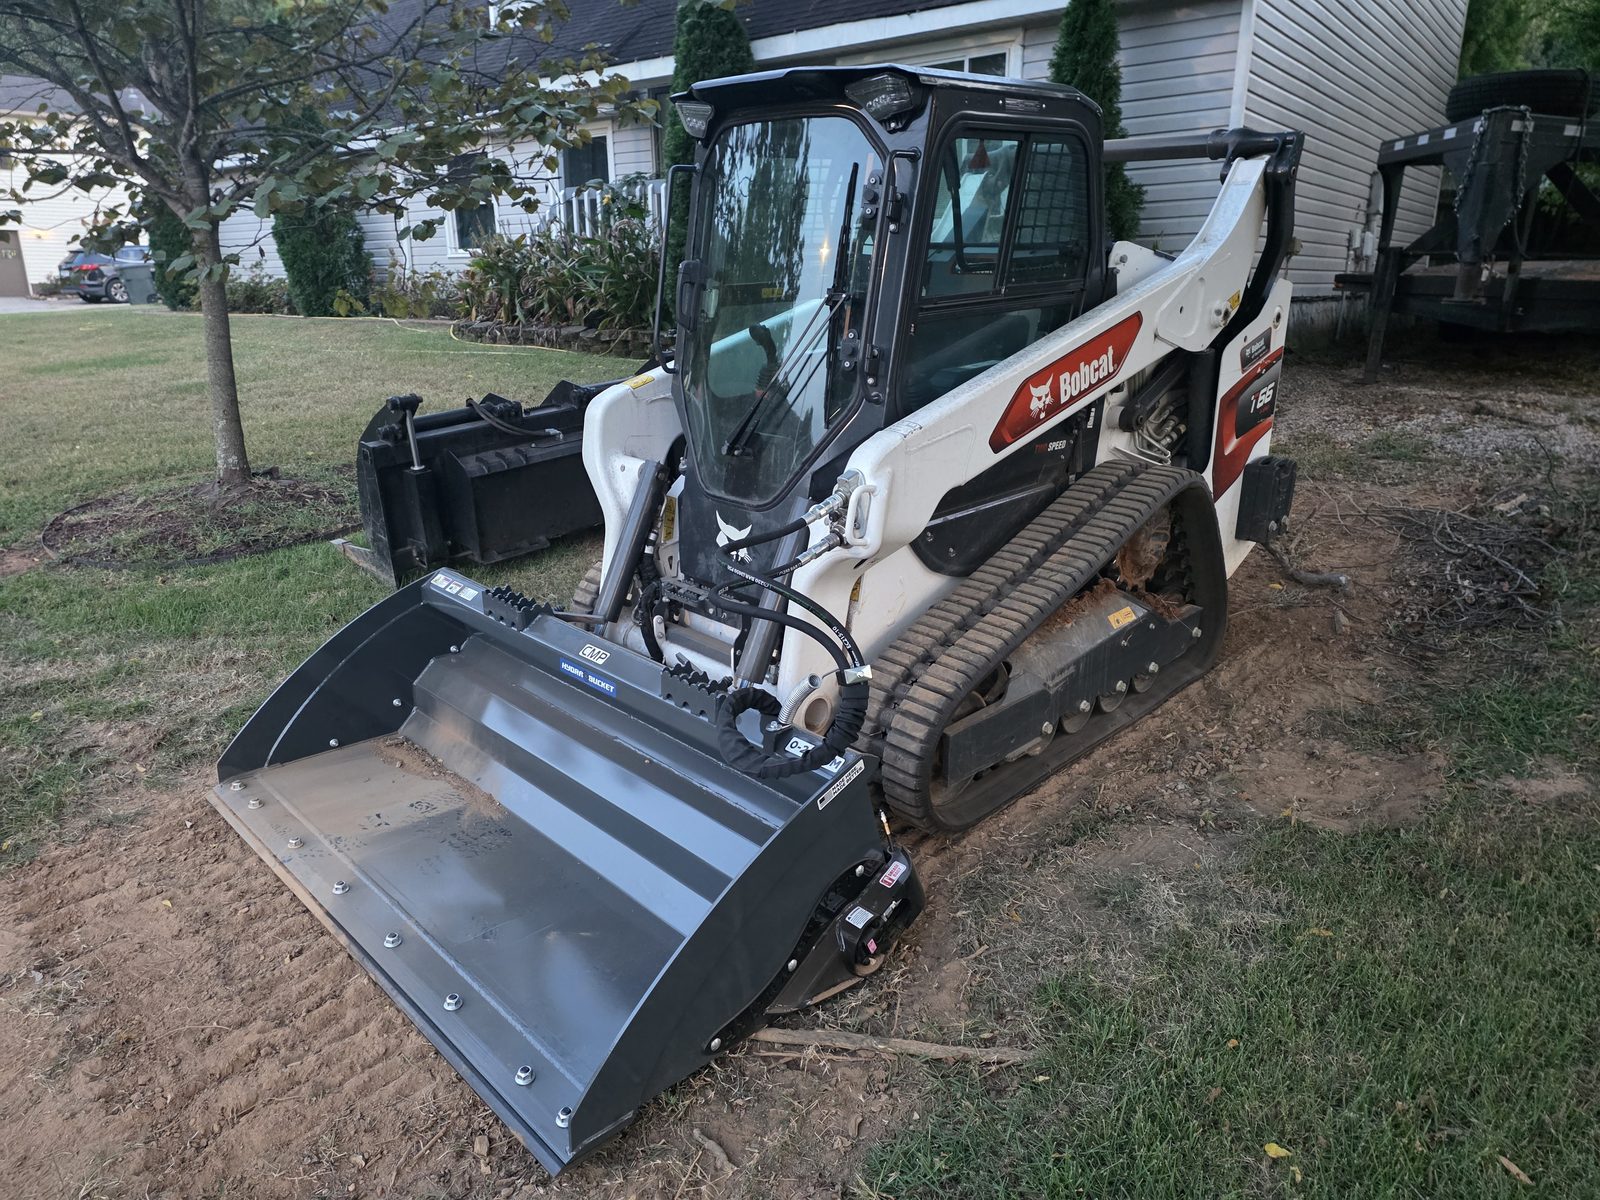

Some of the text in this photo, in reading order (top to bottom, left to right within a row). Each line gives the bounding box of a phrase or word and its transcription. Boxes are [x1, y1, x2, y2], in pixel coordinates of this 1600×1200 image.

[1059, 345, 1115, 404] Bobcat
[581, 645, 608, 662] CMP
[588, 674, 615, 693] BUCKET
